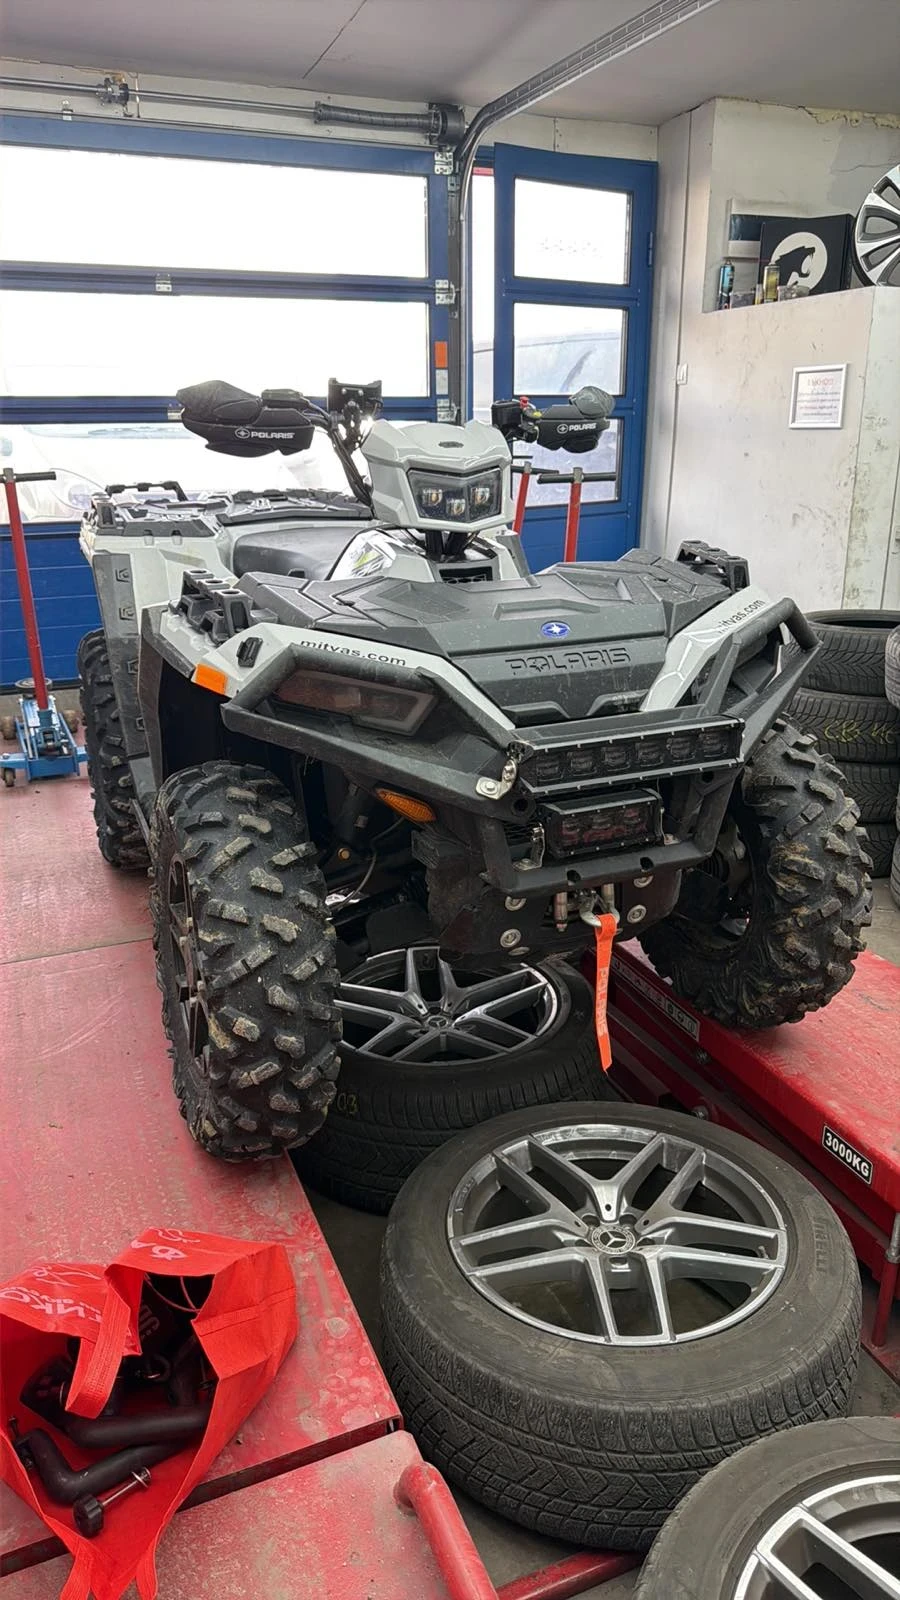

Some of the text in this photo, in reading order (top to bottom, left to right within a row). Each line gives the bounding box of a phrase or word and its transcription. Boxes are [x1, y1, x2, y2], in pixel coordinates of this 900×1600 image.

[251, 431, 295, 439] POLARIS
[569, 422, 597, 431] POLARIS
[300, 640, 406, 666] mitvas.com
[504, 647, 631, 676] POLARIS
[825, 1132, 869, 1177] 3000KG
